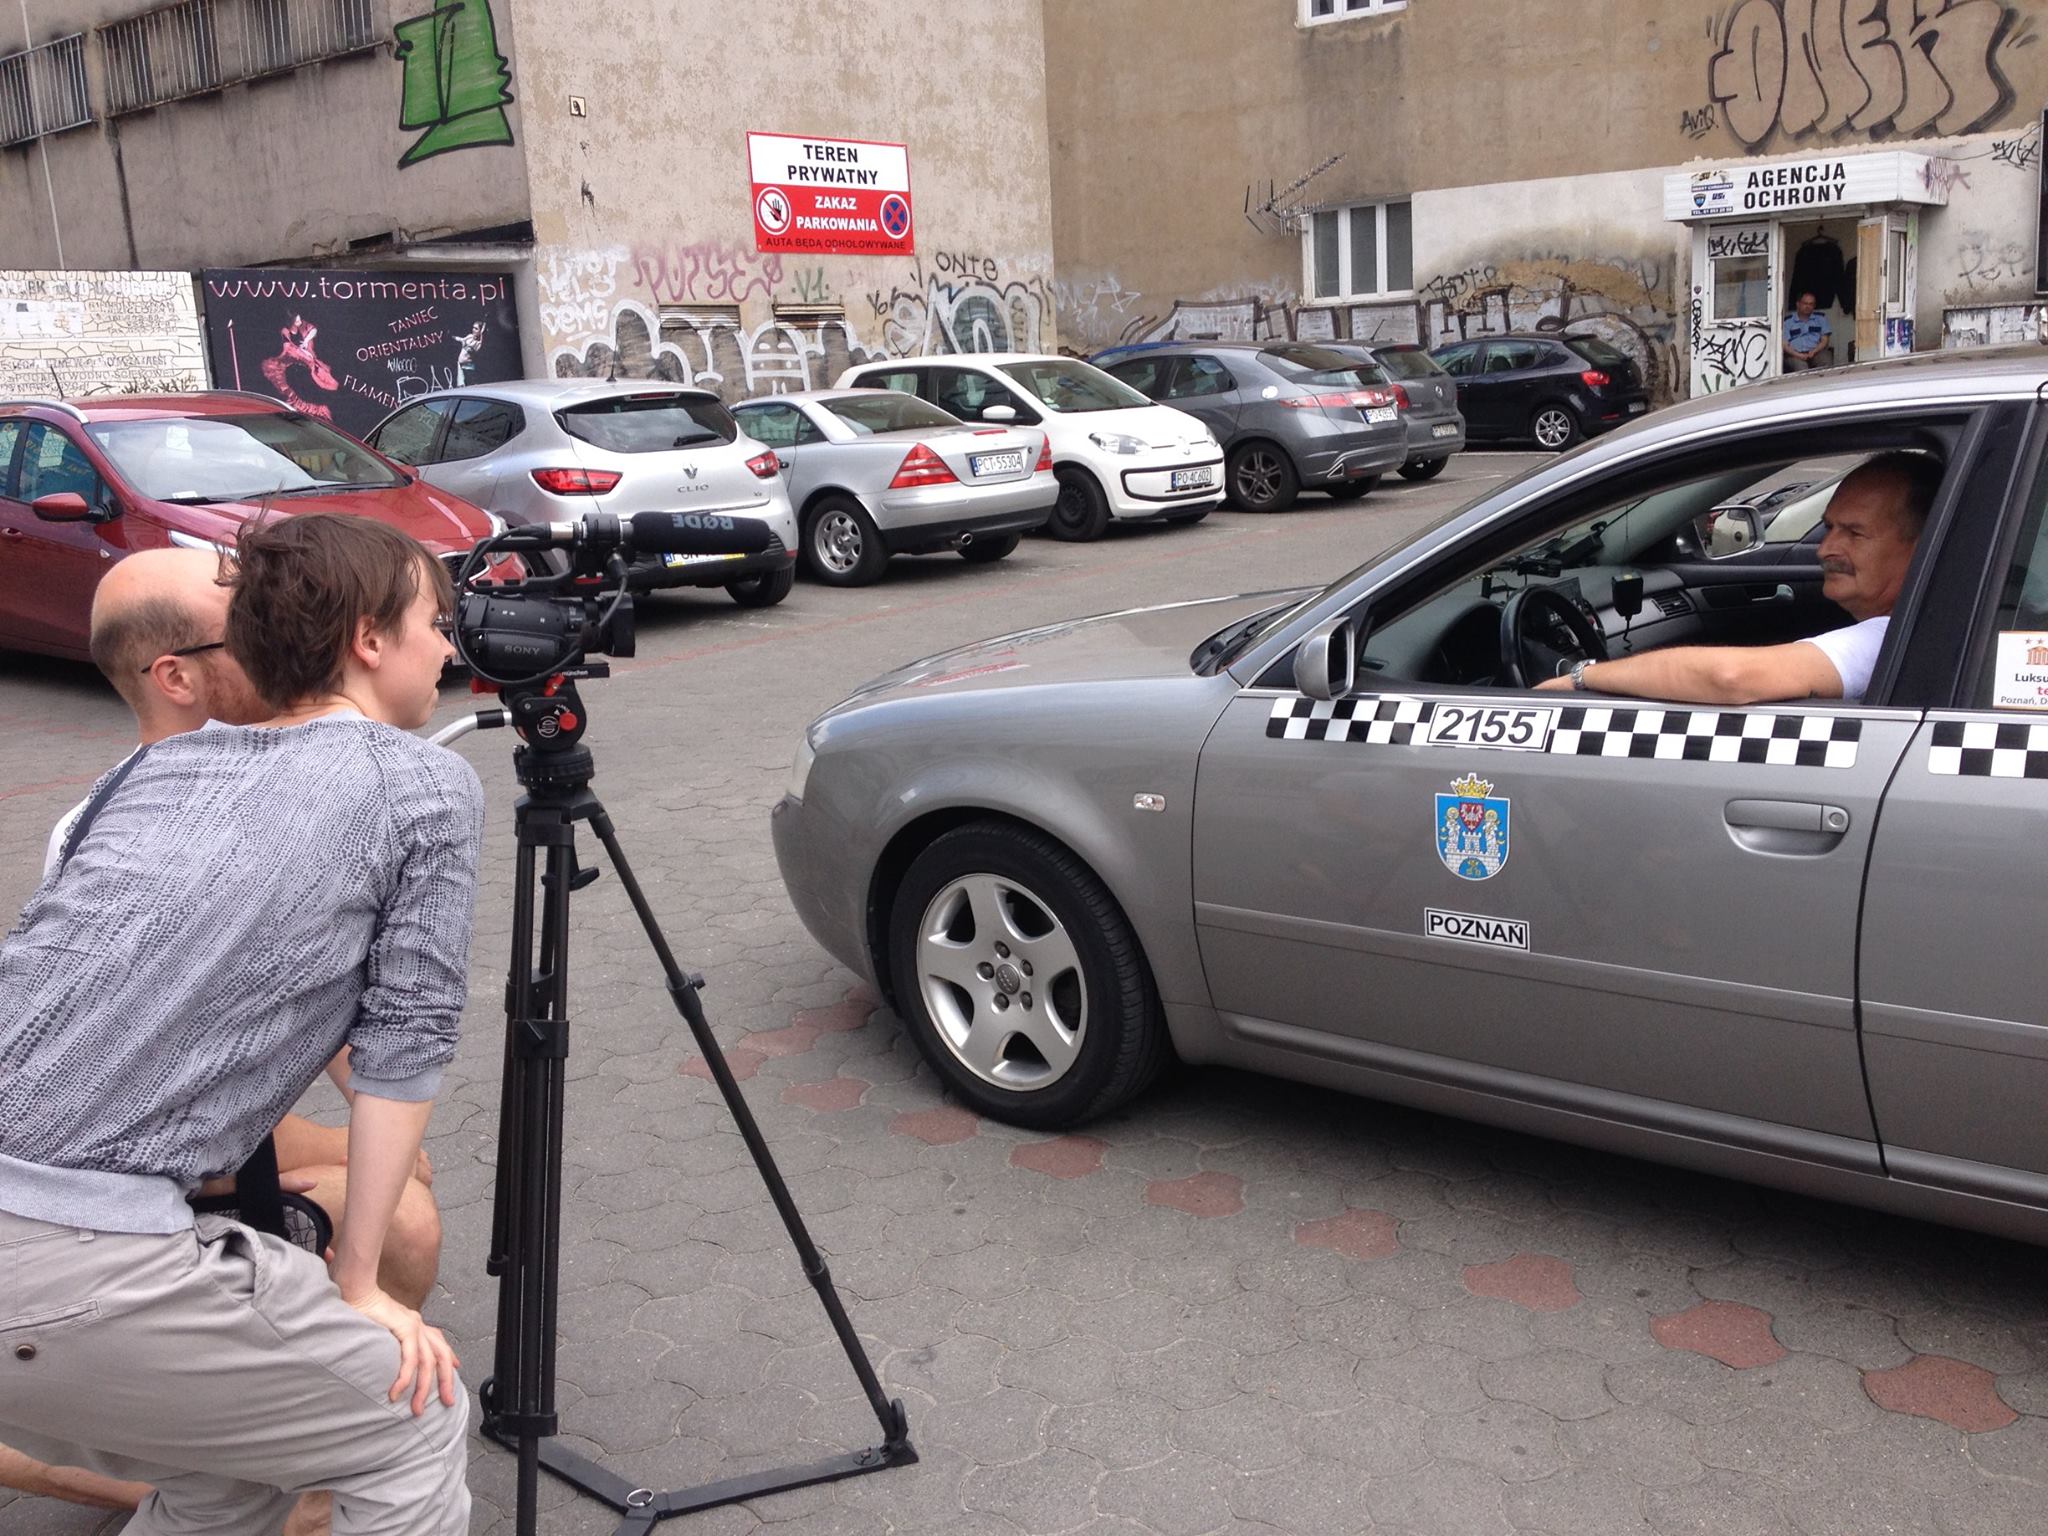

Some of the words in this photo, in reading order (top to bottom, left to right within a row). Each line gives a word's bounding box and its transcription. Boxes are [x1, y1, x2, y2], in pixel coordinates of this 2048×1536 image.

[803, 144, 859, 163] TEREN
[787, 165, 878, 185] PRYWATNY
[1747, 162, 1846, 189] AGENCJA
[815, 195, 857, 210] ZAKAZ
[1744, 183, 1846, 209] OCHRONY
[796, 216, 878, 231] PARKOWANIA
[766, 238, 793, 247] AUTA
[795, 238, 822, 249] BĘDĄ
[825, 239, 905, 250] ODHOLOWYWANE
[208, 276, 505, 306] www.tormenta.pl
[388, 305, 439, 334] TANIEC
[356, 331, 443, 361] ORIENTALNY
[977, 457, 994, 471] PCT
[1177, 472, 1188, 485] PO
[677, 484, 709, 493] CLIO
[504, 644, 541, 655] SONY
[1435, 708, 1538, 744] 2155
[1430, 914, 1524, 946] POZNAŃ
